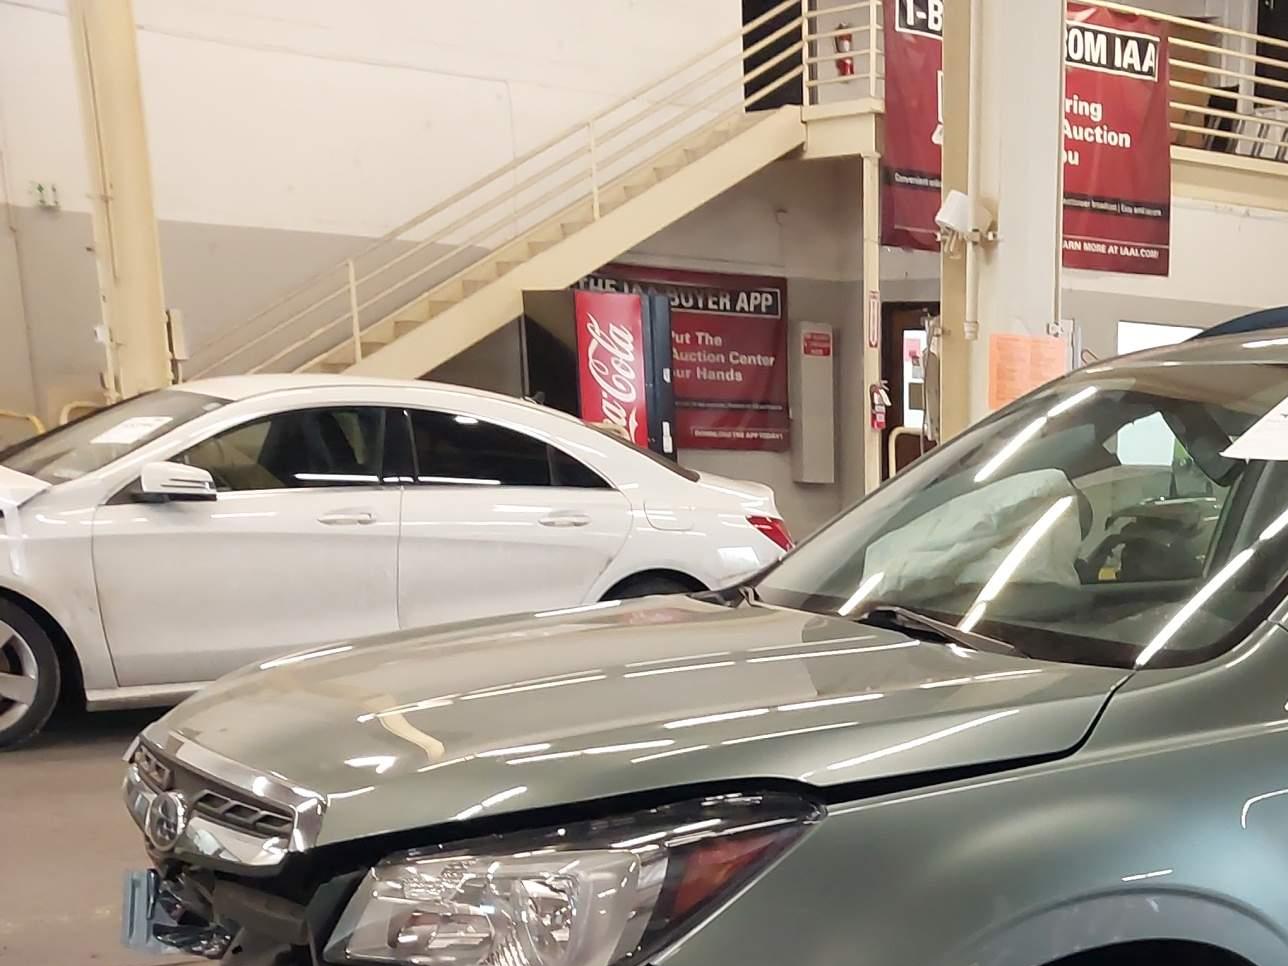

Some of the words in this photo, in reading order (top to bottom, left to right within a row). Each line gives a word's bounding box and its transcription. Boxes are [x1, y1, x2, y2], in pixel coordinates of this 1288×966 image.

[1065, 27, 1107, 65] OM
[1114, 36, 1157, 73] IAA
[1064, 94, 1102, 122] ring
[1063, 118, 1131, 148] Auction
[1063, 240, 1081, 251] ARN
[1083, 242, 1106, 254] MORE
[1108, 245, 1118, 255] AT
[735, 292, 773, 313] APP
[695, 331, 722, 347] The
[672, 347, 725, 363] Auction
[728, 351, 775, 366] Center
[696, 366, 743, 382] Hands
